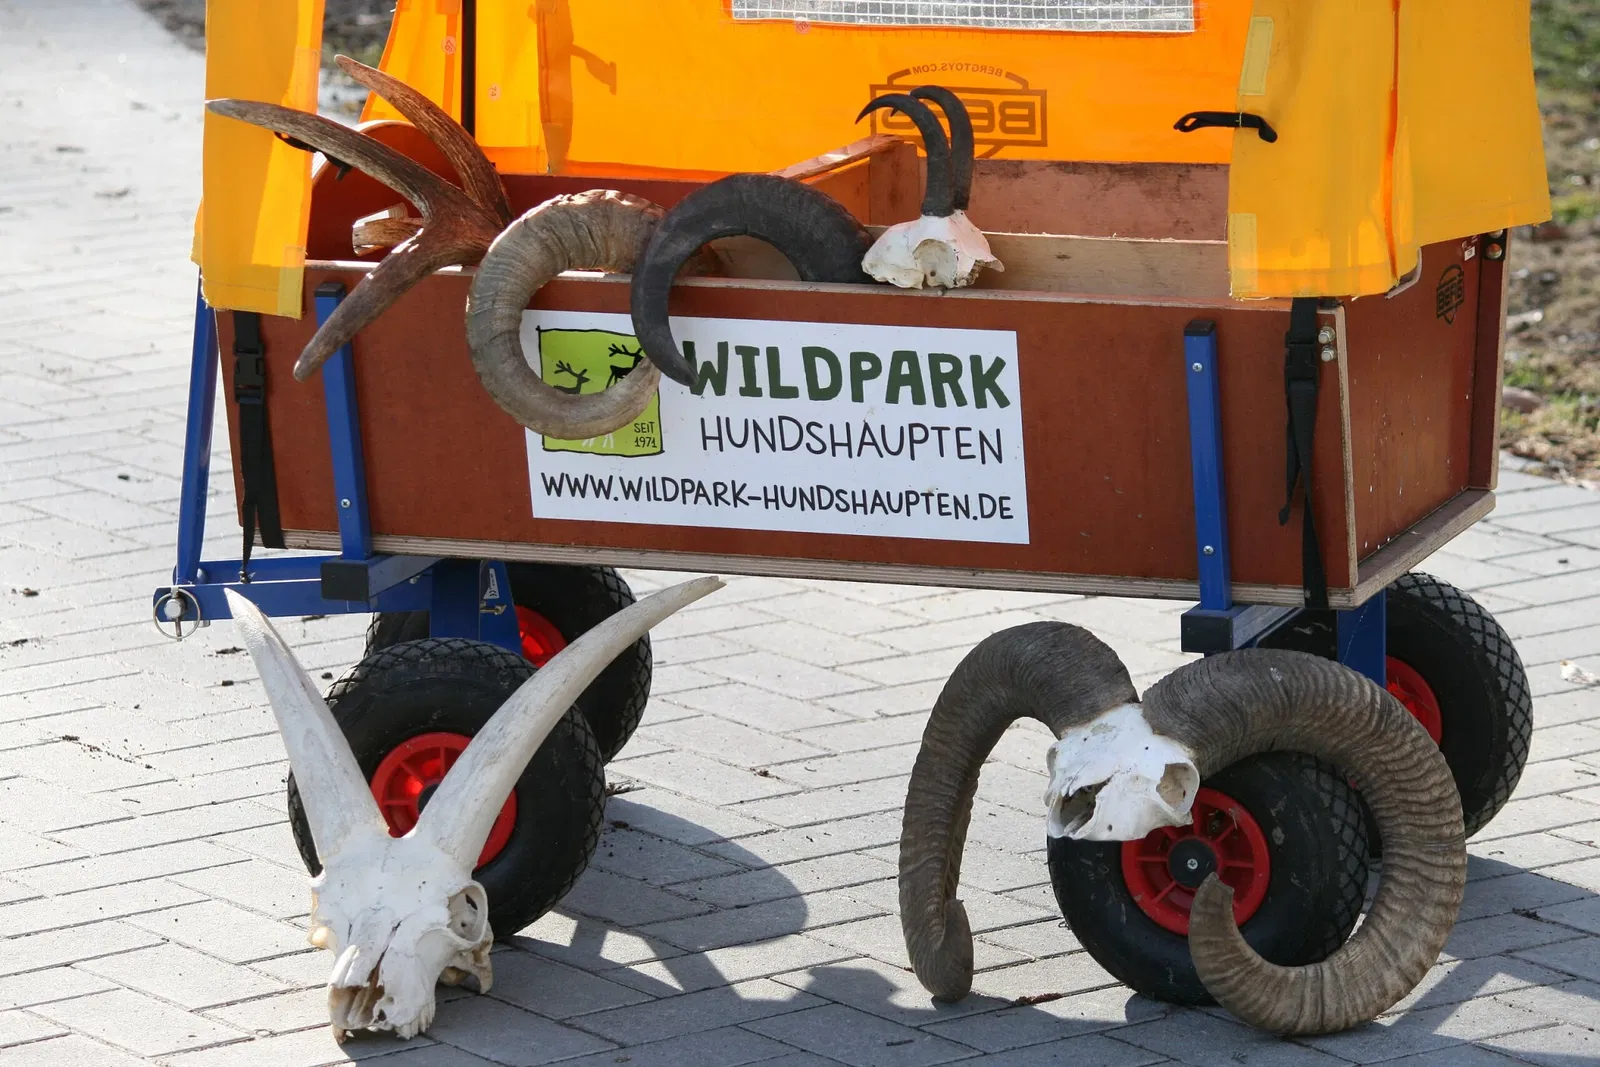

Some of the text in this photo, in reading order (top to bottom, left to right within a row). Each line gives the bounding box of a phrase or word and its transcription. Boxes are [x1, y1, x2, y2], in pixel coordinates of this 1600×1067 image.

[682, 340, 1011, 410] WILDPARK
[633, 421, 655, 434] SEIT
[634, 436, 658, 449] 1971
[700, 415, 1003, 465] HUNDSHAUPTEN
[540, 472, 1014, 521] WWW.WILDPARK-HUNDSHAUPTEN.DE
